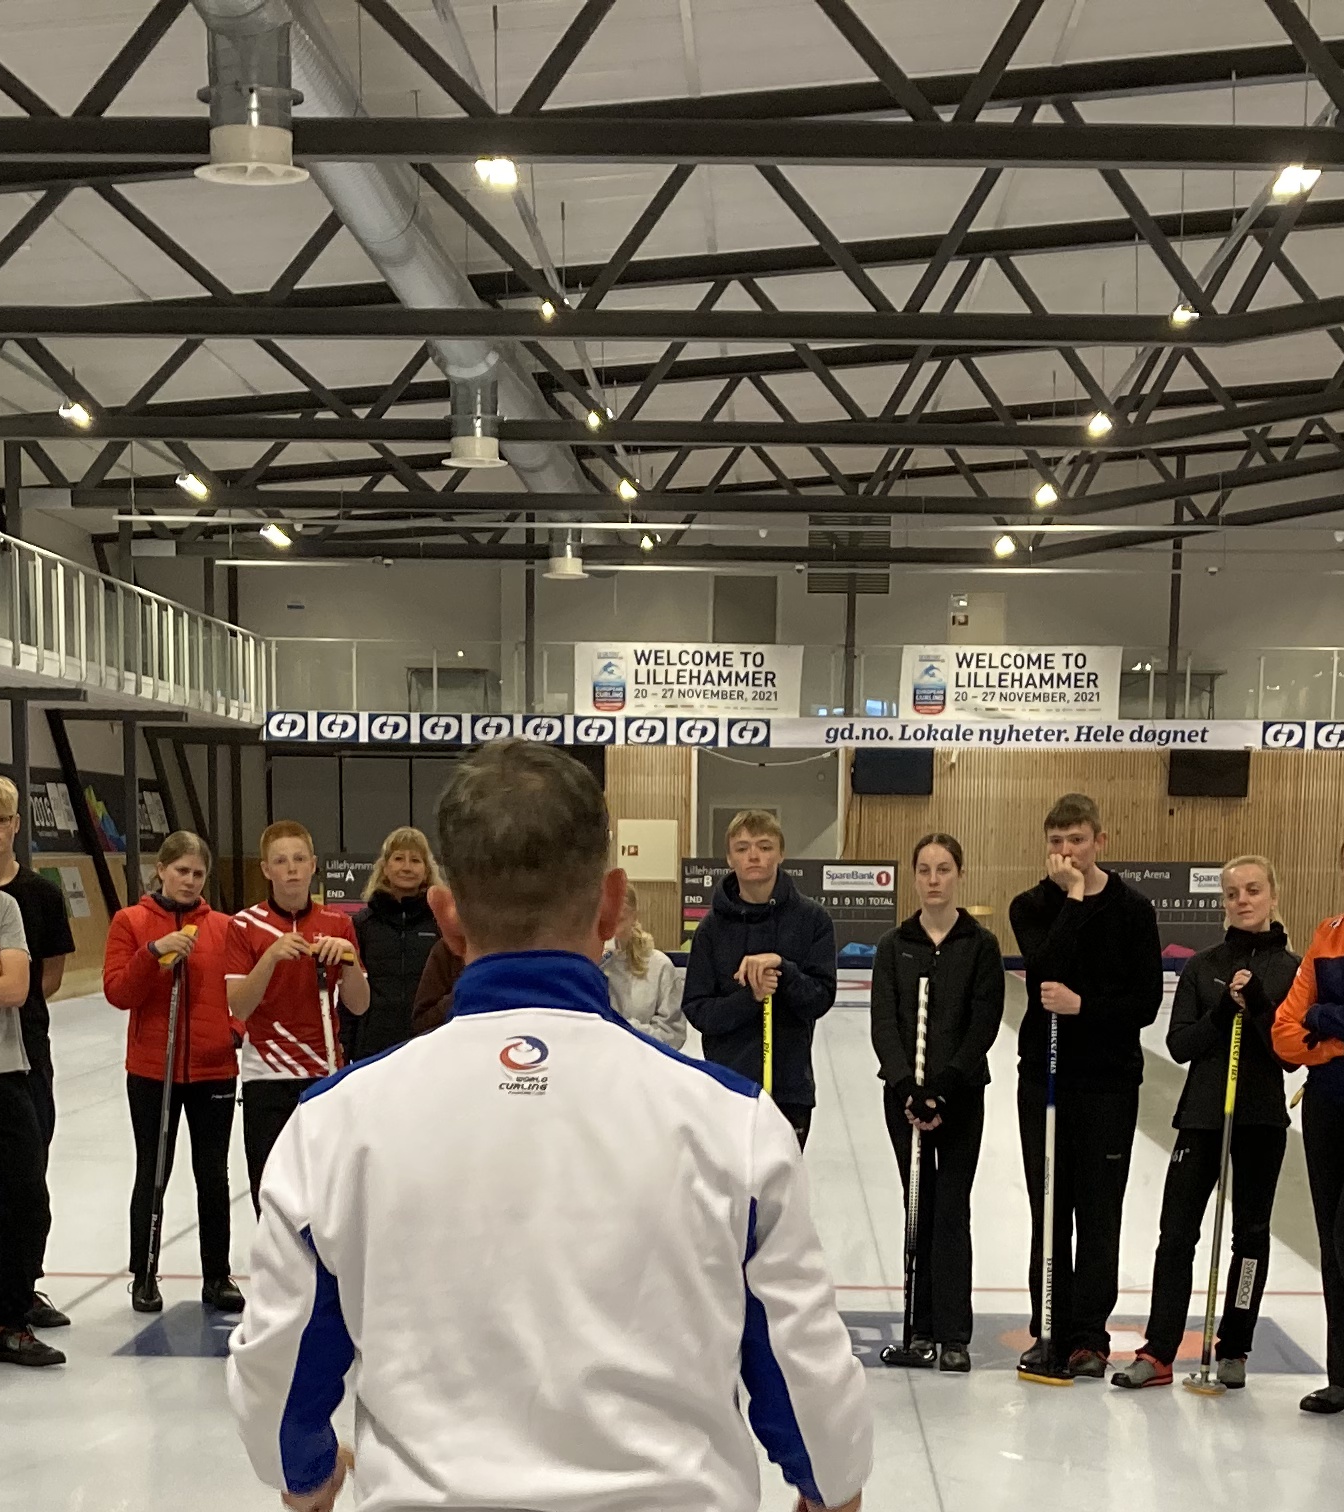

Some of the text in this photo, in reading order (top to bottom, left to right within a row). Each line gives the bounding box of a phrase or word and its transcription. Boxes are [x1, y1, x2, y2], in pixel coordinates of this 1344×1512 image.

[634, 648, 734, 668] WELCOME
[740, 651, 765, 668] TO
[956, 652, 1055, 670] WELCOME
[1062, 652, 1087, 670] TO
[634, 668, 777, 687] LILLEHAMMER
[955, 671, 1099, 689] LILLEHAMMER
[634, 688, 648, 699] 20
[661, 688, 674, 699] 27
[677, 688, 748, 702] NOVEMBER,
[752, 690, 778, 701] 2021
[954, 691, 968, 702] 20
[982, 691, 995, 702] 27
[999, 691, 1070, 704] NOVEMBER,
[1074, 691, 1100, 703] 2021
[825, 724, 894, 744] gd.no.
[898, 724, 973, 743] Lokale
[978, 725, 1071, 745] nyheter.
[1074, 726, 1125, 743] Hele
[1128, 726, 1209, 746] døgnet
[326, 860, 375, 871] Lillehamm
[684, 865, 732, 876] Lillehamm
[345, 869, 355, 882] A
[826, 869, 874, 881] SpareBank
[1143, 869, 1171, 880] Arena
[1192, 872, 1219, 884] Spare
[704, 875, 713, 887] B
[326, 889, 345, 899] END
[684, 896, 894, 906] END 7 8 9 10 TOTAL
[1162, 900, 1168, 908] 5
[1174, 900, 1180, 908] 6
[1187, 900, 1192, 908] 7
[1199, 900, 1204, 908] 8
[1236, 1259, 1256, 1308] SWEROCK
